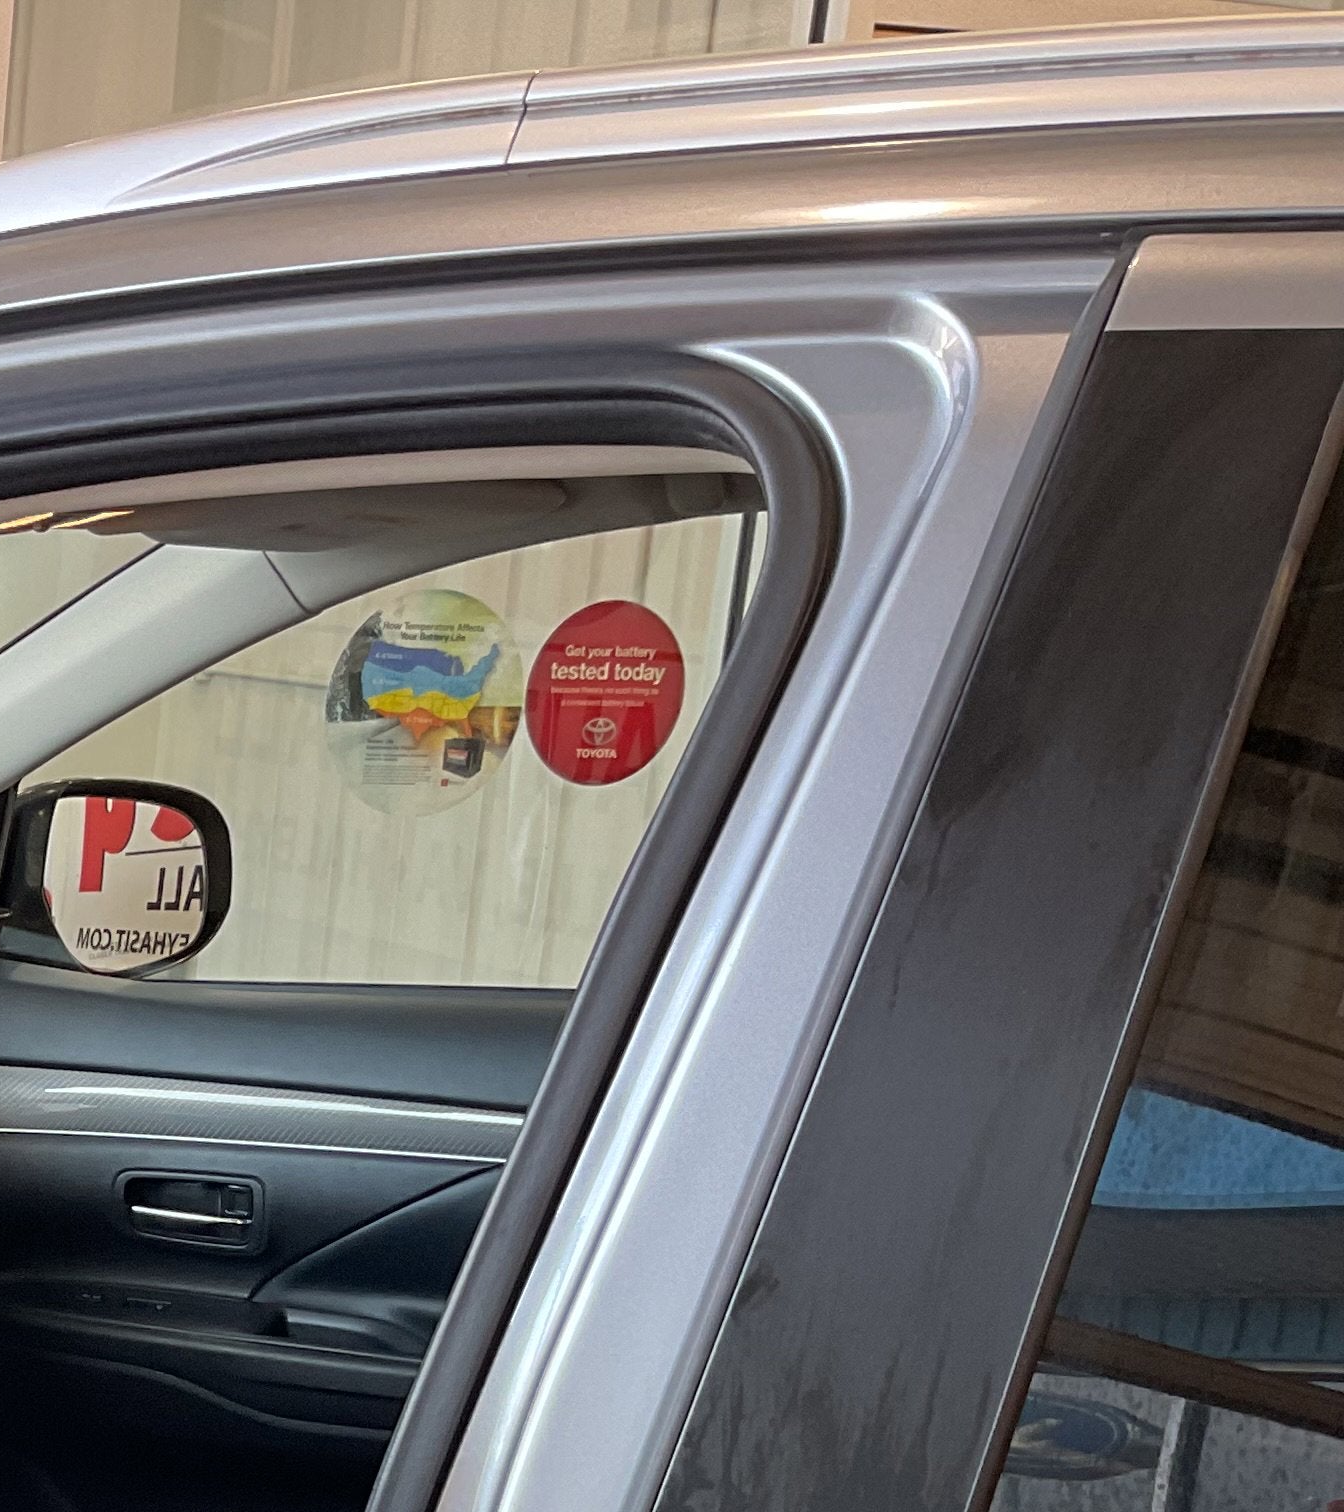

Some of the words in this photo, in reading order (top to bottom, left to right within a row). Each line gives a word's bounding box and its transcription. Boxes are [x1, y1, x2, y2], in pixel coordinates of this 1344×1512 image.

[565, 645, 586, 657] Get
[588, 648, 613, 659] your
[615, 646, 656, 660] battery
[551, 662, 610, 680] tested
[614, 662, 666, 685] today
[576, 748, 617, 759] TOYOTA
